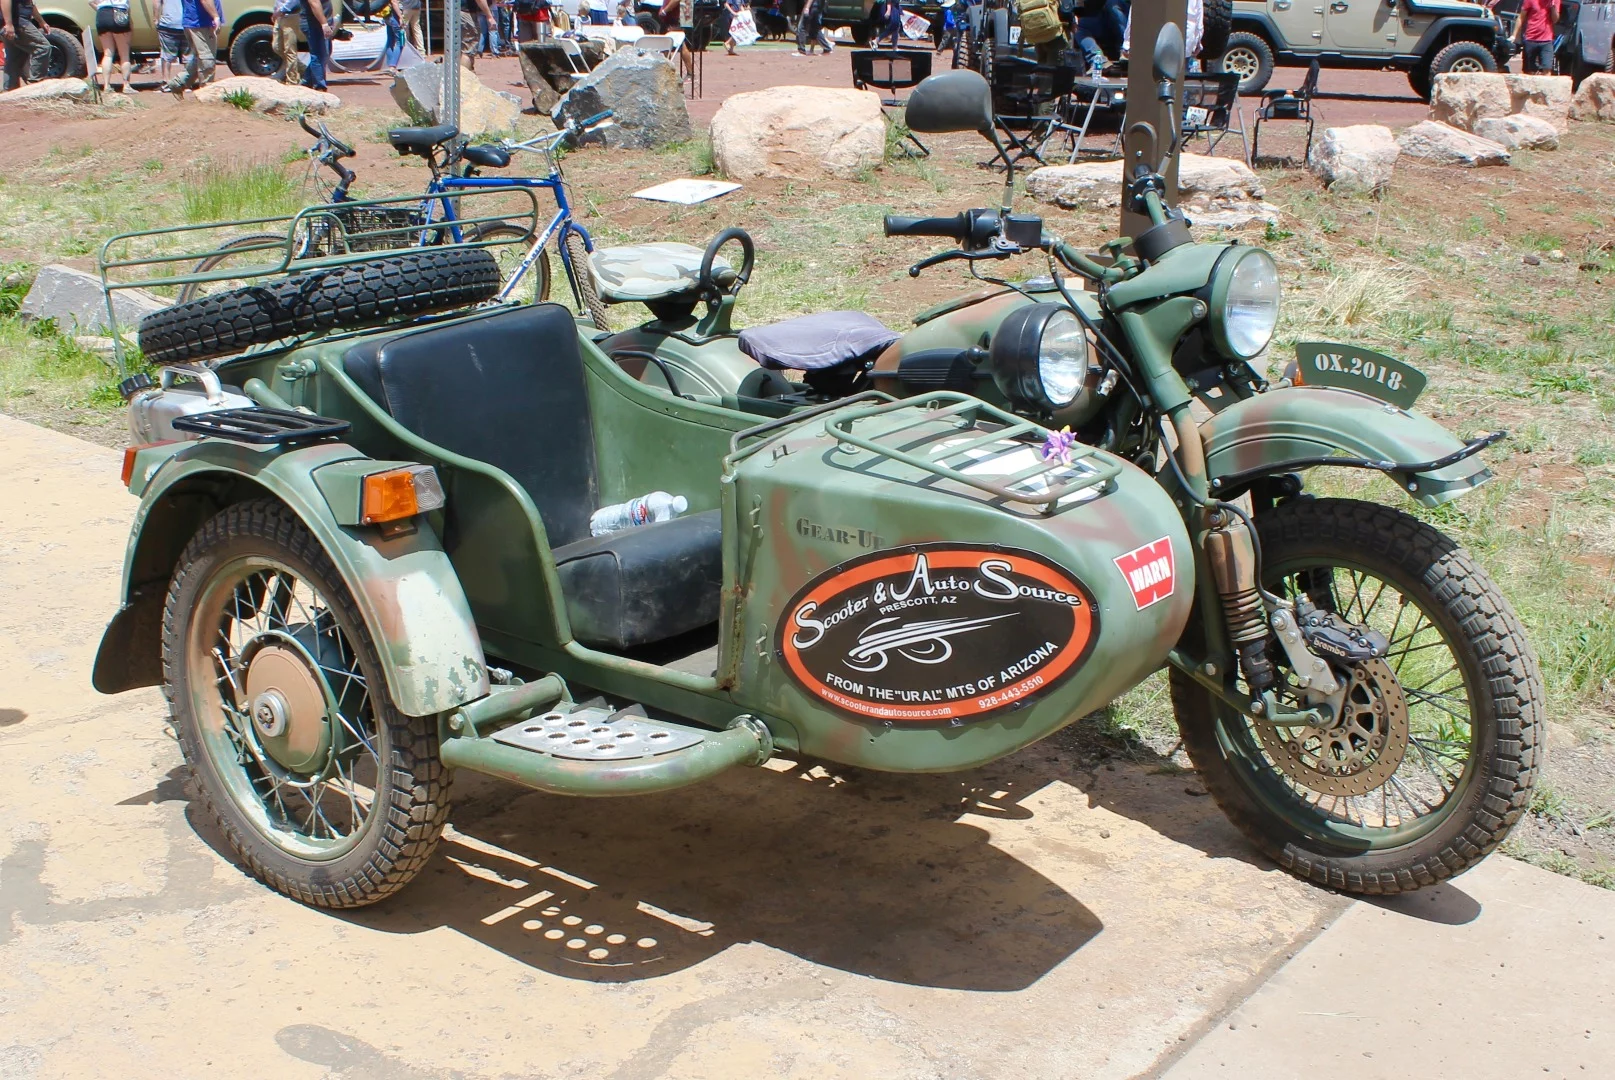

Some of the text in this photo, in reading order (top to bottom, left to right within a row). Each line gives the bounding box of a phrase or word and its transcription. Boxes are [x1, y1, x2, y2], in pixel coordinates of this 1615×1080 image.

[1129, 556, 1171, 593] WARN
[792, 553, 1081, 649] Scooter & Auto Source
[879, 596, 957, 615] PRESCOTT, AZ
[1313, 637, 1346, 657] brembo
[825, 672, 864, 695] FROM
[946, 683, 976, 699] MTS
[978, 675, 996, 691] OF
[1000, 641, 1058, 682] ARIZONA
[821, 687, 951, 717] www.scooterandautosource.com
[978, 675, 1044, 709] 928-443-5510
